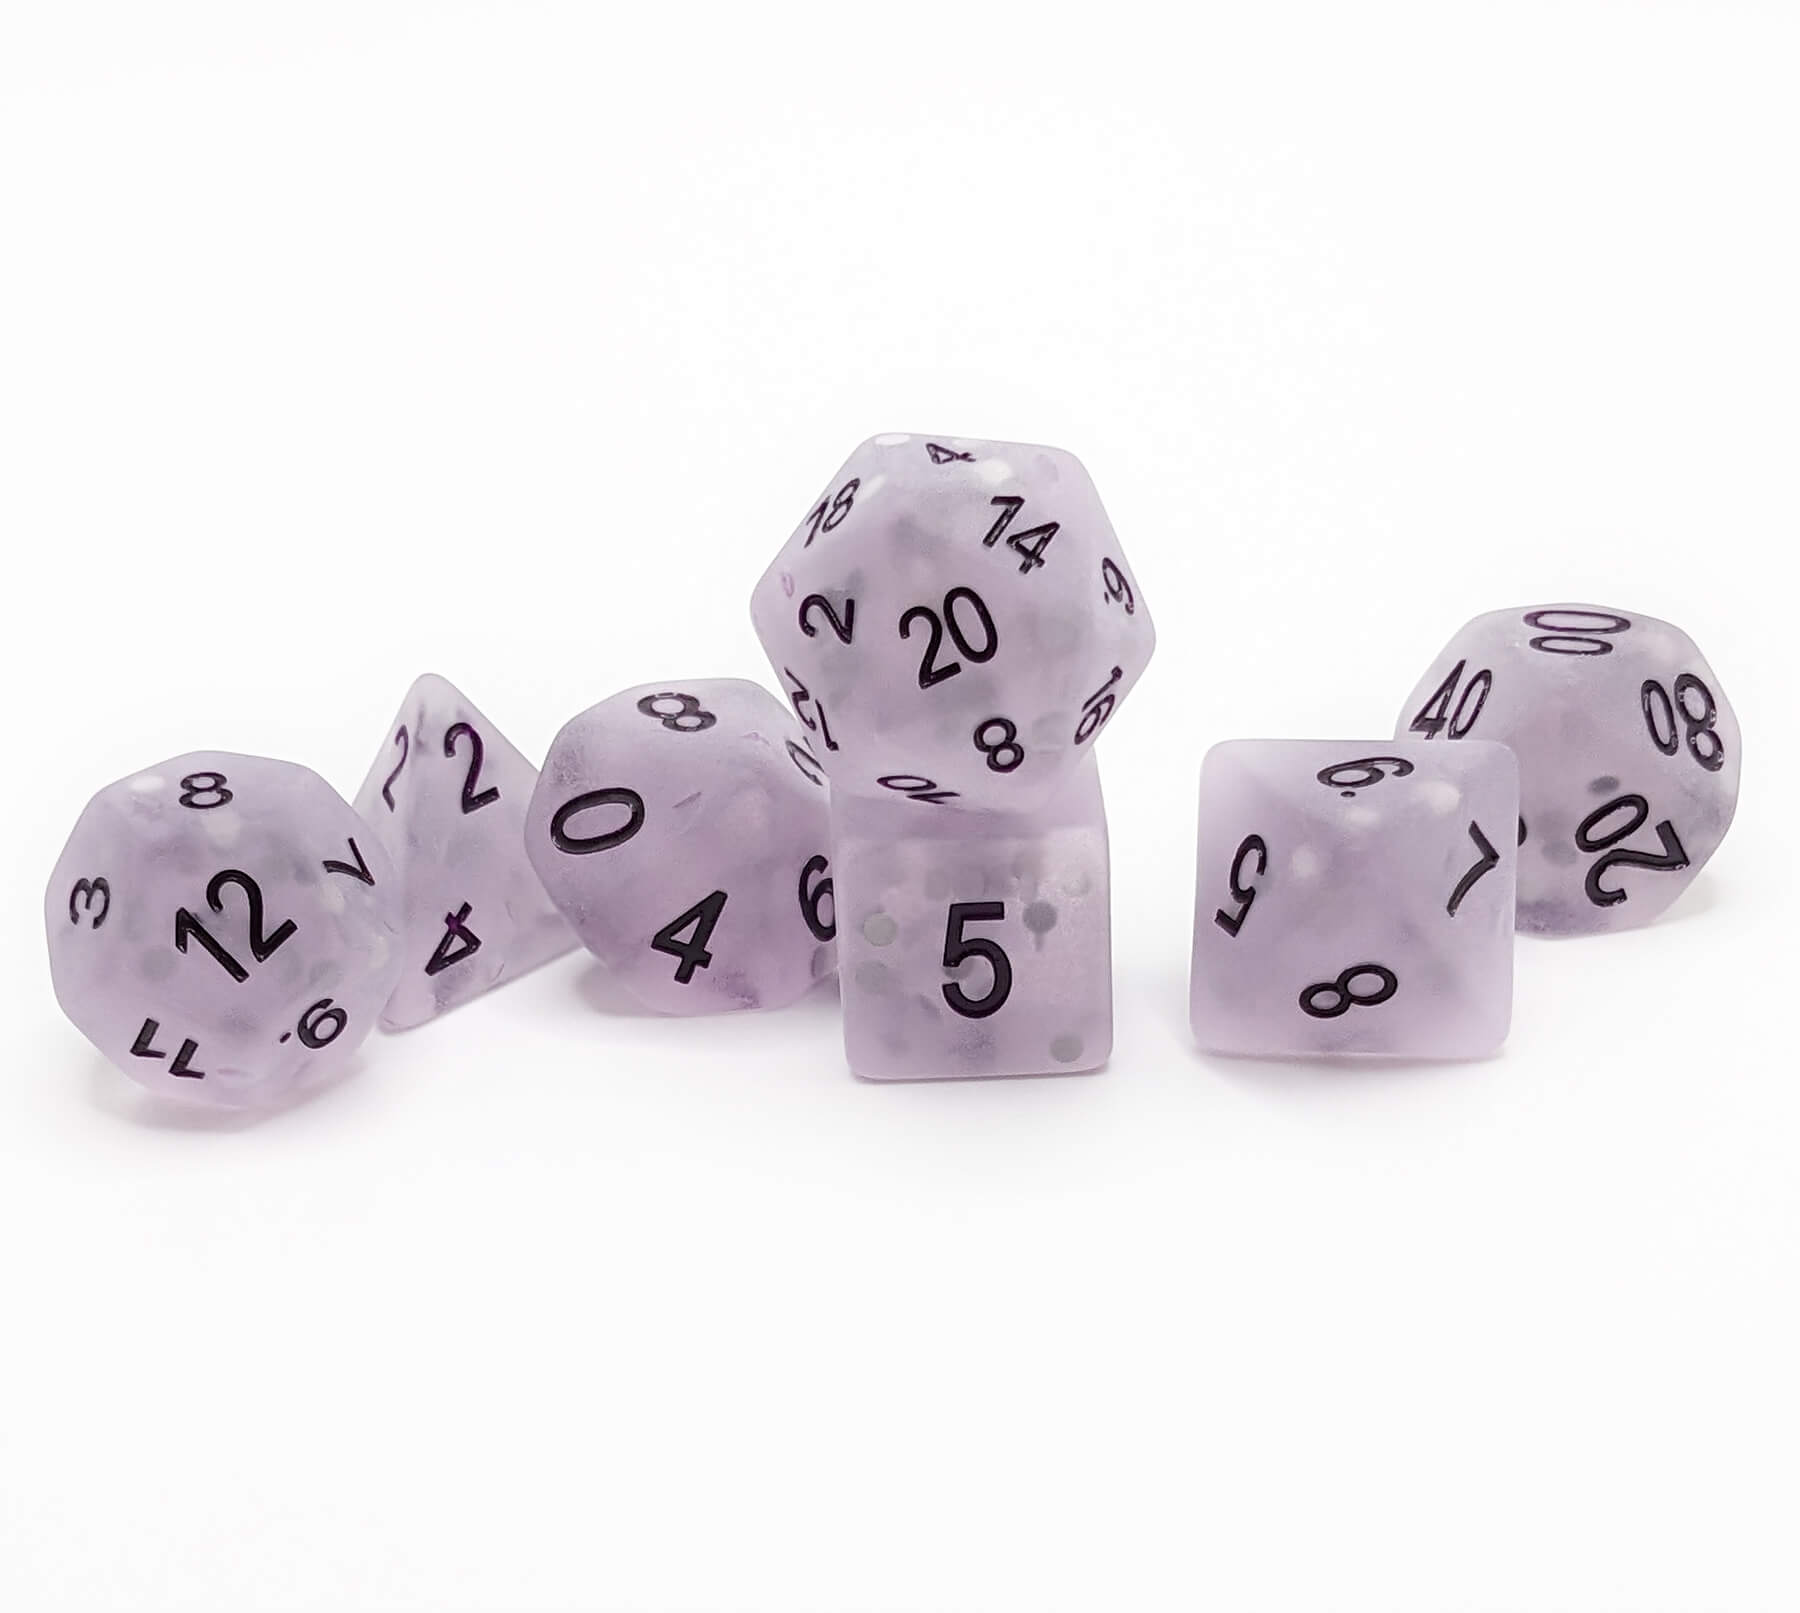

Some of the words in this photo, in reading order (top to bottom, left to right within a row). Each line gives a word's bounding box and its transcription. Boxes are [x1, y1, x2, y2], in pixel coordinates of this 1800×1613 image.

[804, 478, 860, 548] 18
[982, 495, 1060, 575] 14
[798, 593, 856, 645] 2
[898, 586, 999, 690] 20
[1525, 610, 1631, 656] 00
[637, 692, 717, 732] 8
[1074, 665, 1123, 745] 16
[1411, 659, 1493, 740] 40
[1640, 673, 1724, 772] 80
[384, 726, 409, 812] 2
[443, 721, 500, 815] 2
[972, 716, 1025, 774] 8
[178, 772, 234, 810] 8
[549, 787, 646, 854] 0
[876, 774, 961, 805] 10
[322, 837, 376, 887] 7
[1214, 833, 1268, 938] 5
[1446, 820, 1500, 918] 7
[1574, 793, 1691, 908] 20
[69, 876, 111, 930] 3
[173, 869, 299, 984] 12
[424, 901, 482, 977] 4
[650, 889, 729, 985] 4
[941, 900, 1013, 1020] 5
[1298, 963, 1399, 1019] 8
